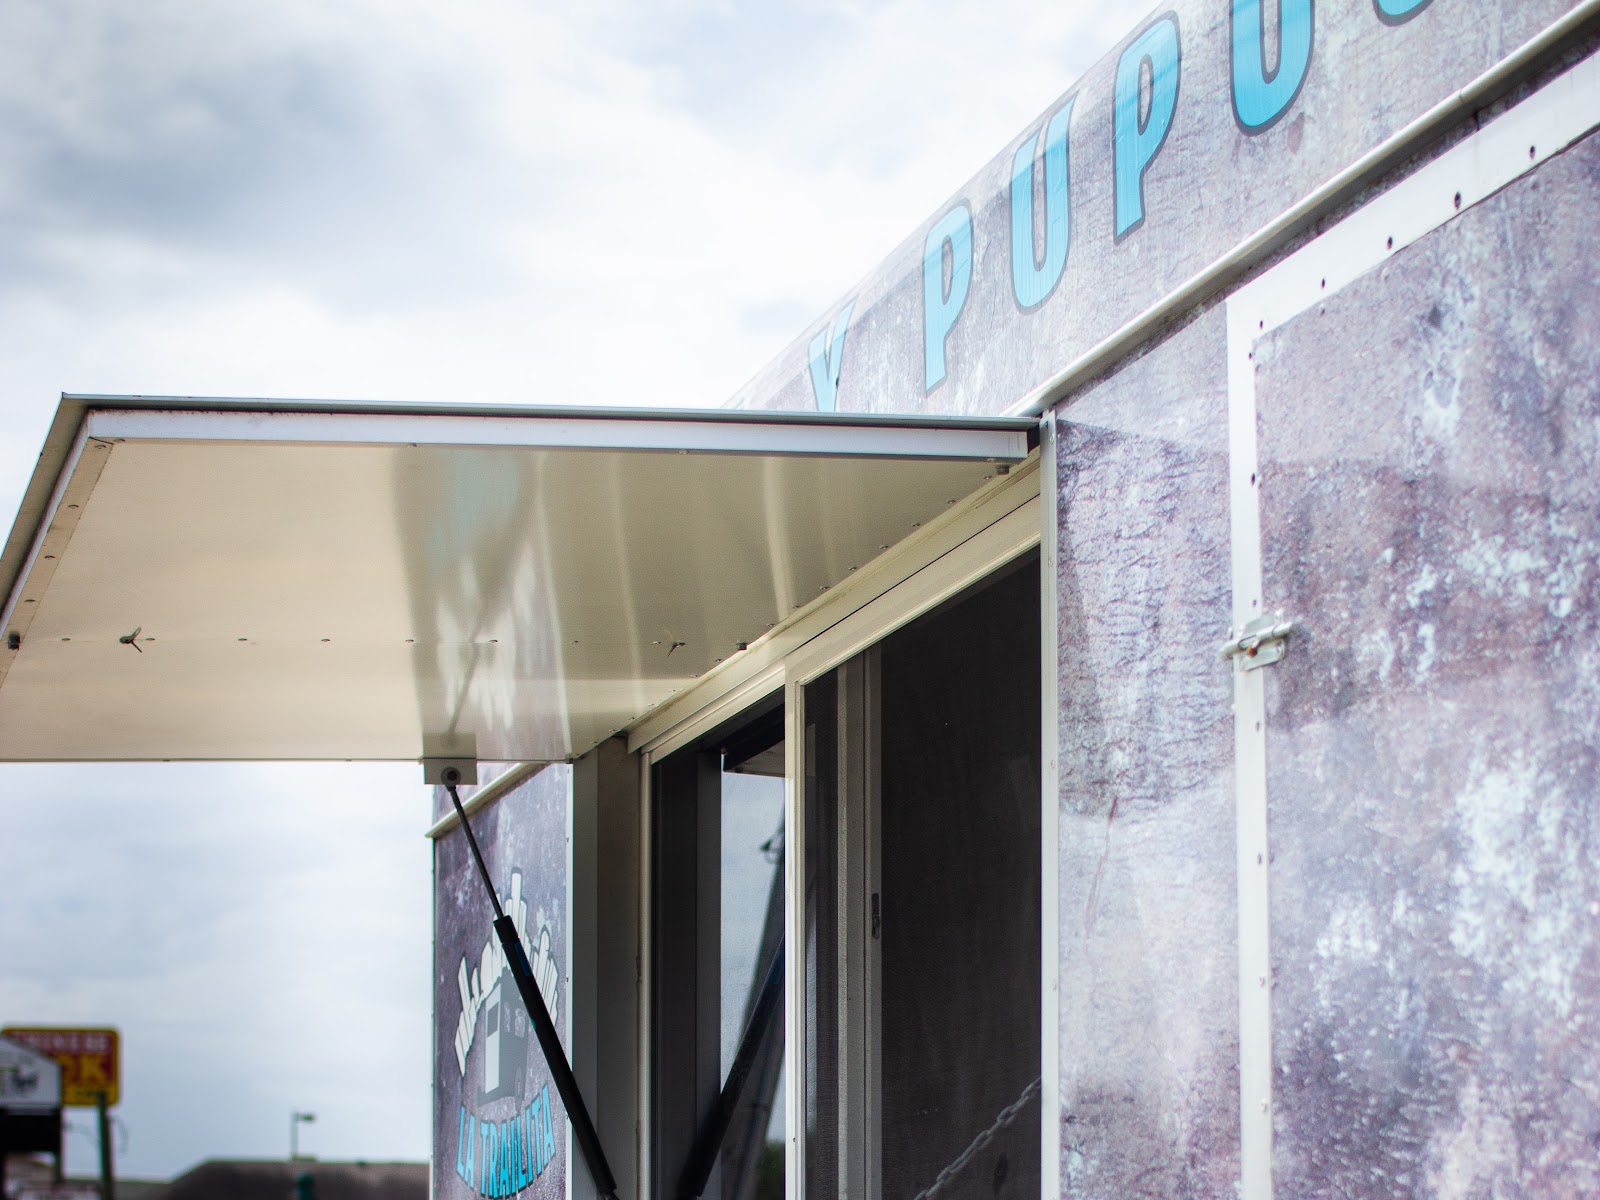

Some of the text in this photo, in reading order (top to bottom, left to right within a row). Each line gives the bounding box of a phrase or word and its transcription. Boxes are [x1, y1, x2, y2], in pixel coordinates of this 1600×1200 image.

[921, 0, 1434, 398] PUPU
[456, 1082, 557, 1200] LA TRAILITA
